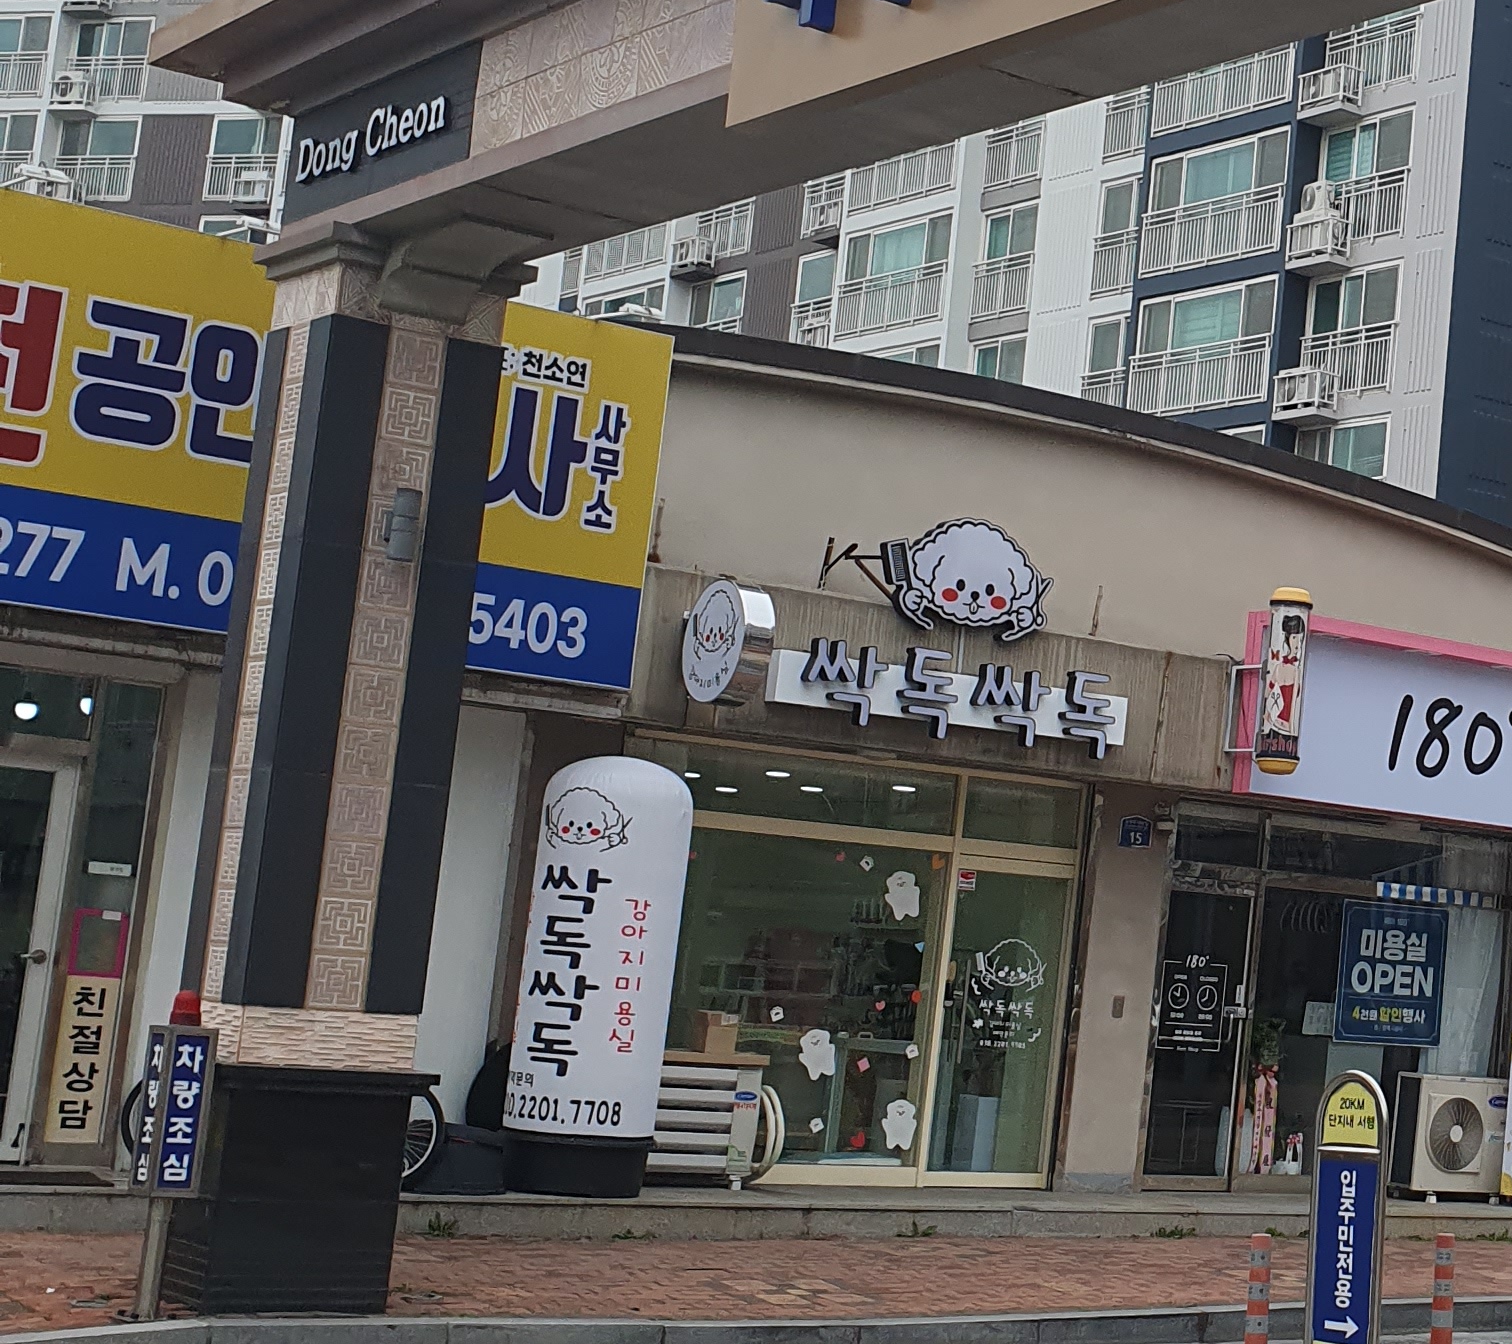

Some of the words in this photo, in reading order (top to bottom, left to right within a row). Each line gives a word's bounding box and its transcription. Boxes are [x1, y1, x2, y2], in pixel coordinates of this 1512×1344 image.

[296, 128, 359, 183] Dong
[365, 95, 446, 157] Cheon
[521, 348, 590, 389] 천소연
[581, 402, 631, 533] 사무소
[468, 591, 589, 660] 5403
[801, 637, 1117, 758] 싹독싹독
[1129, 831, 1143, 845] 15
[526, 863, 613, 1078] 싹독싹독
[1351, 961, 1434, 997] OPEN
[1360, 928, 1428, 963] 미용실
[57, 985, 107, 1130] 친절상담
[163, 1042, 204, 1183] 차량조심
[1328, 1113, 1355, 1129] 단지내
[1357, 1115, 1375, 1130] 서행
[1339, 1097, 1365, 1111] 20KM
[1333, 1169, 1358, 1310] 입주민전용
